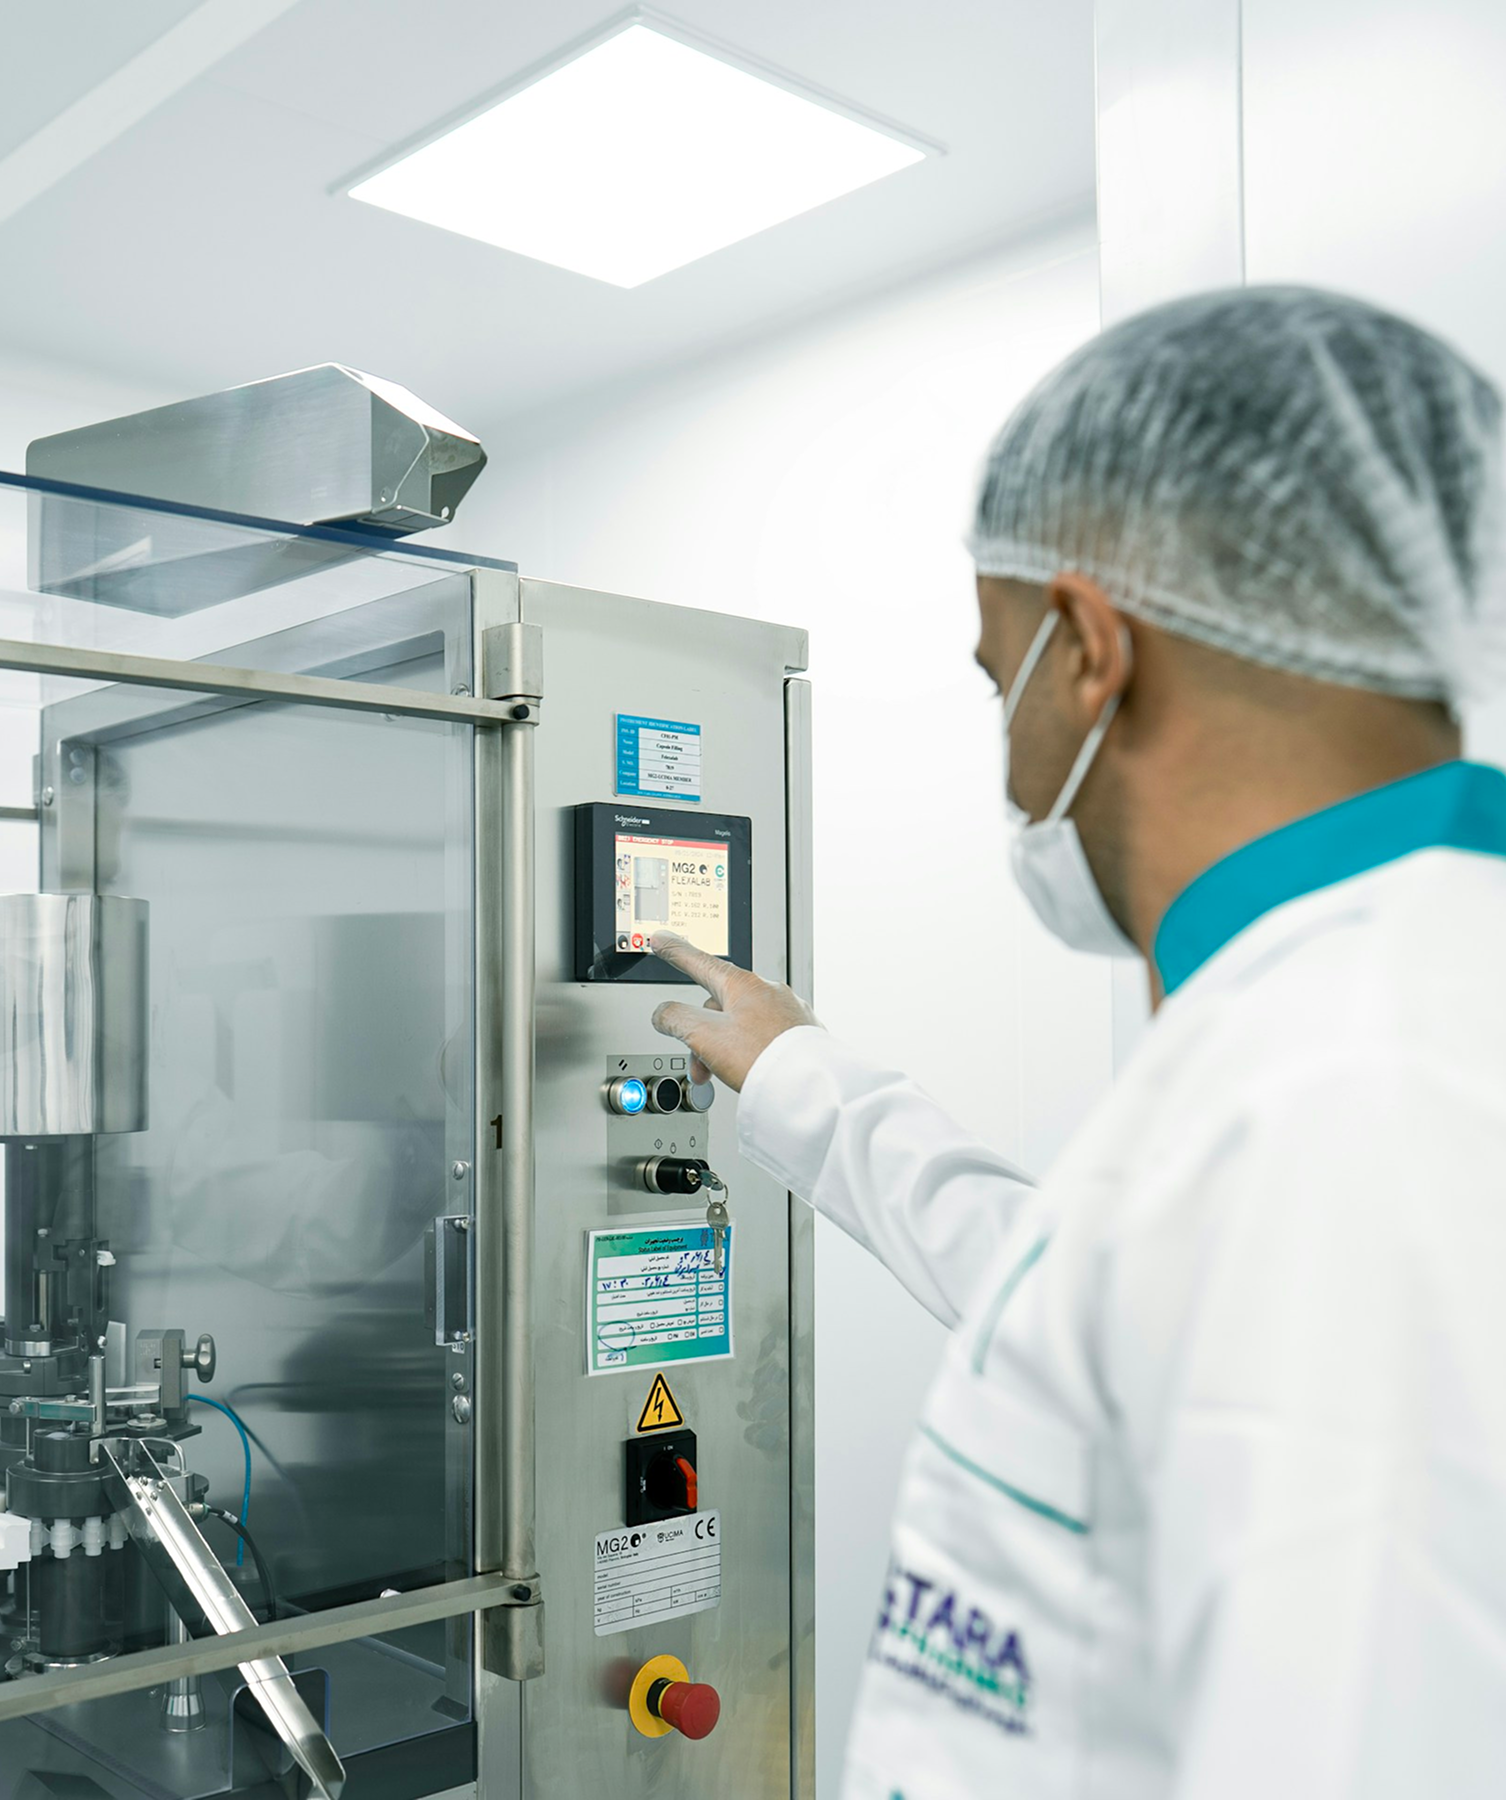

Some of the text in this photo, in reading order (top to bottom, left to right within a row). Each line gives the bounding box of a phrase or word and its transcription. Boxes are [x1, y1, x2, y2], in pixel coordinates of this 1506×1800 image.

[614, 814, 642, 826] Schneider
[672, 862, 696, 874] MG2
[672, 876, 710, 886] FLEXALAB
[490, 1114, 502, 1149] 1
[597, 1536, 628, 1556] MG2
[664, 1530, 684, 1540] UCIMA
[695, 1516, 716, 1540] CE
